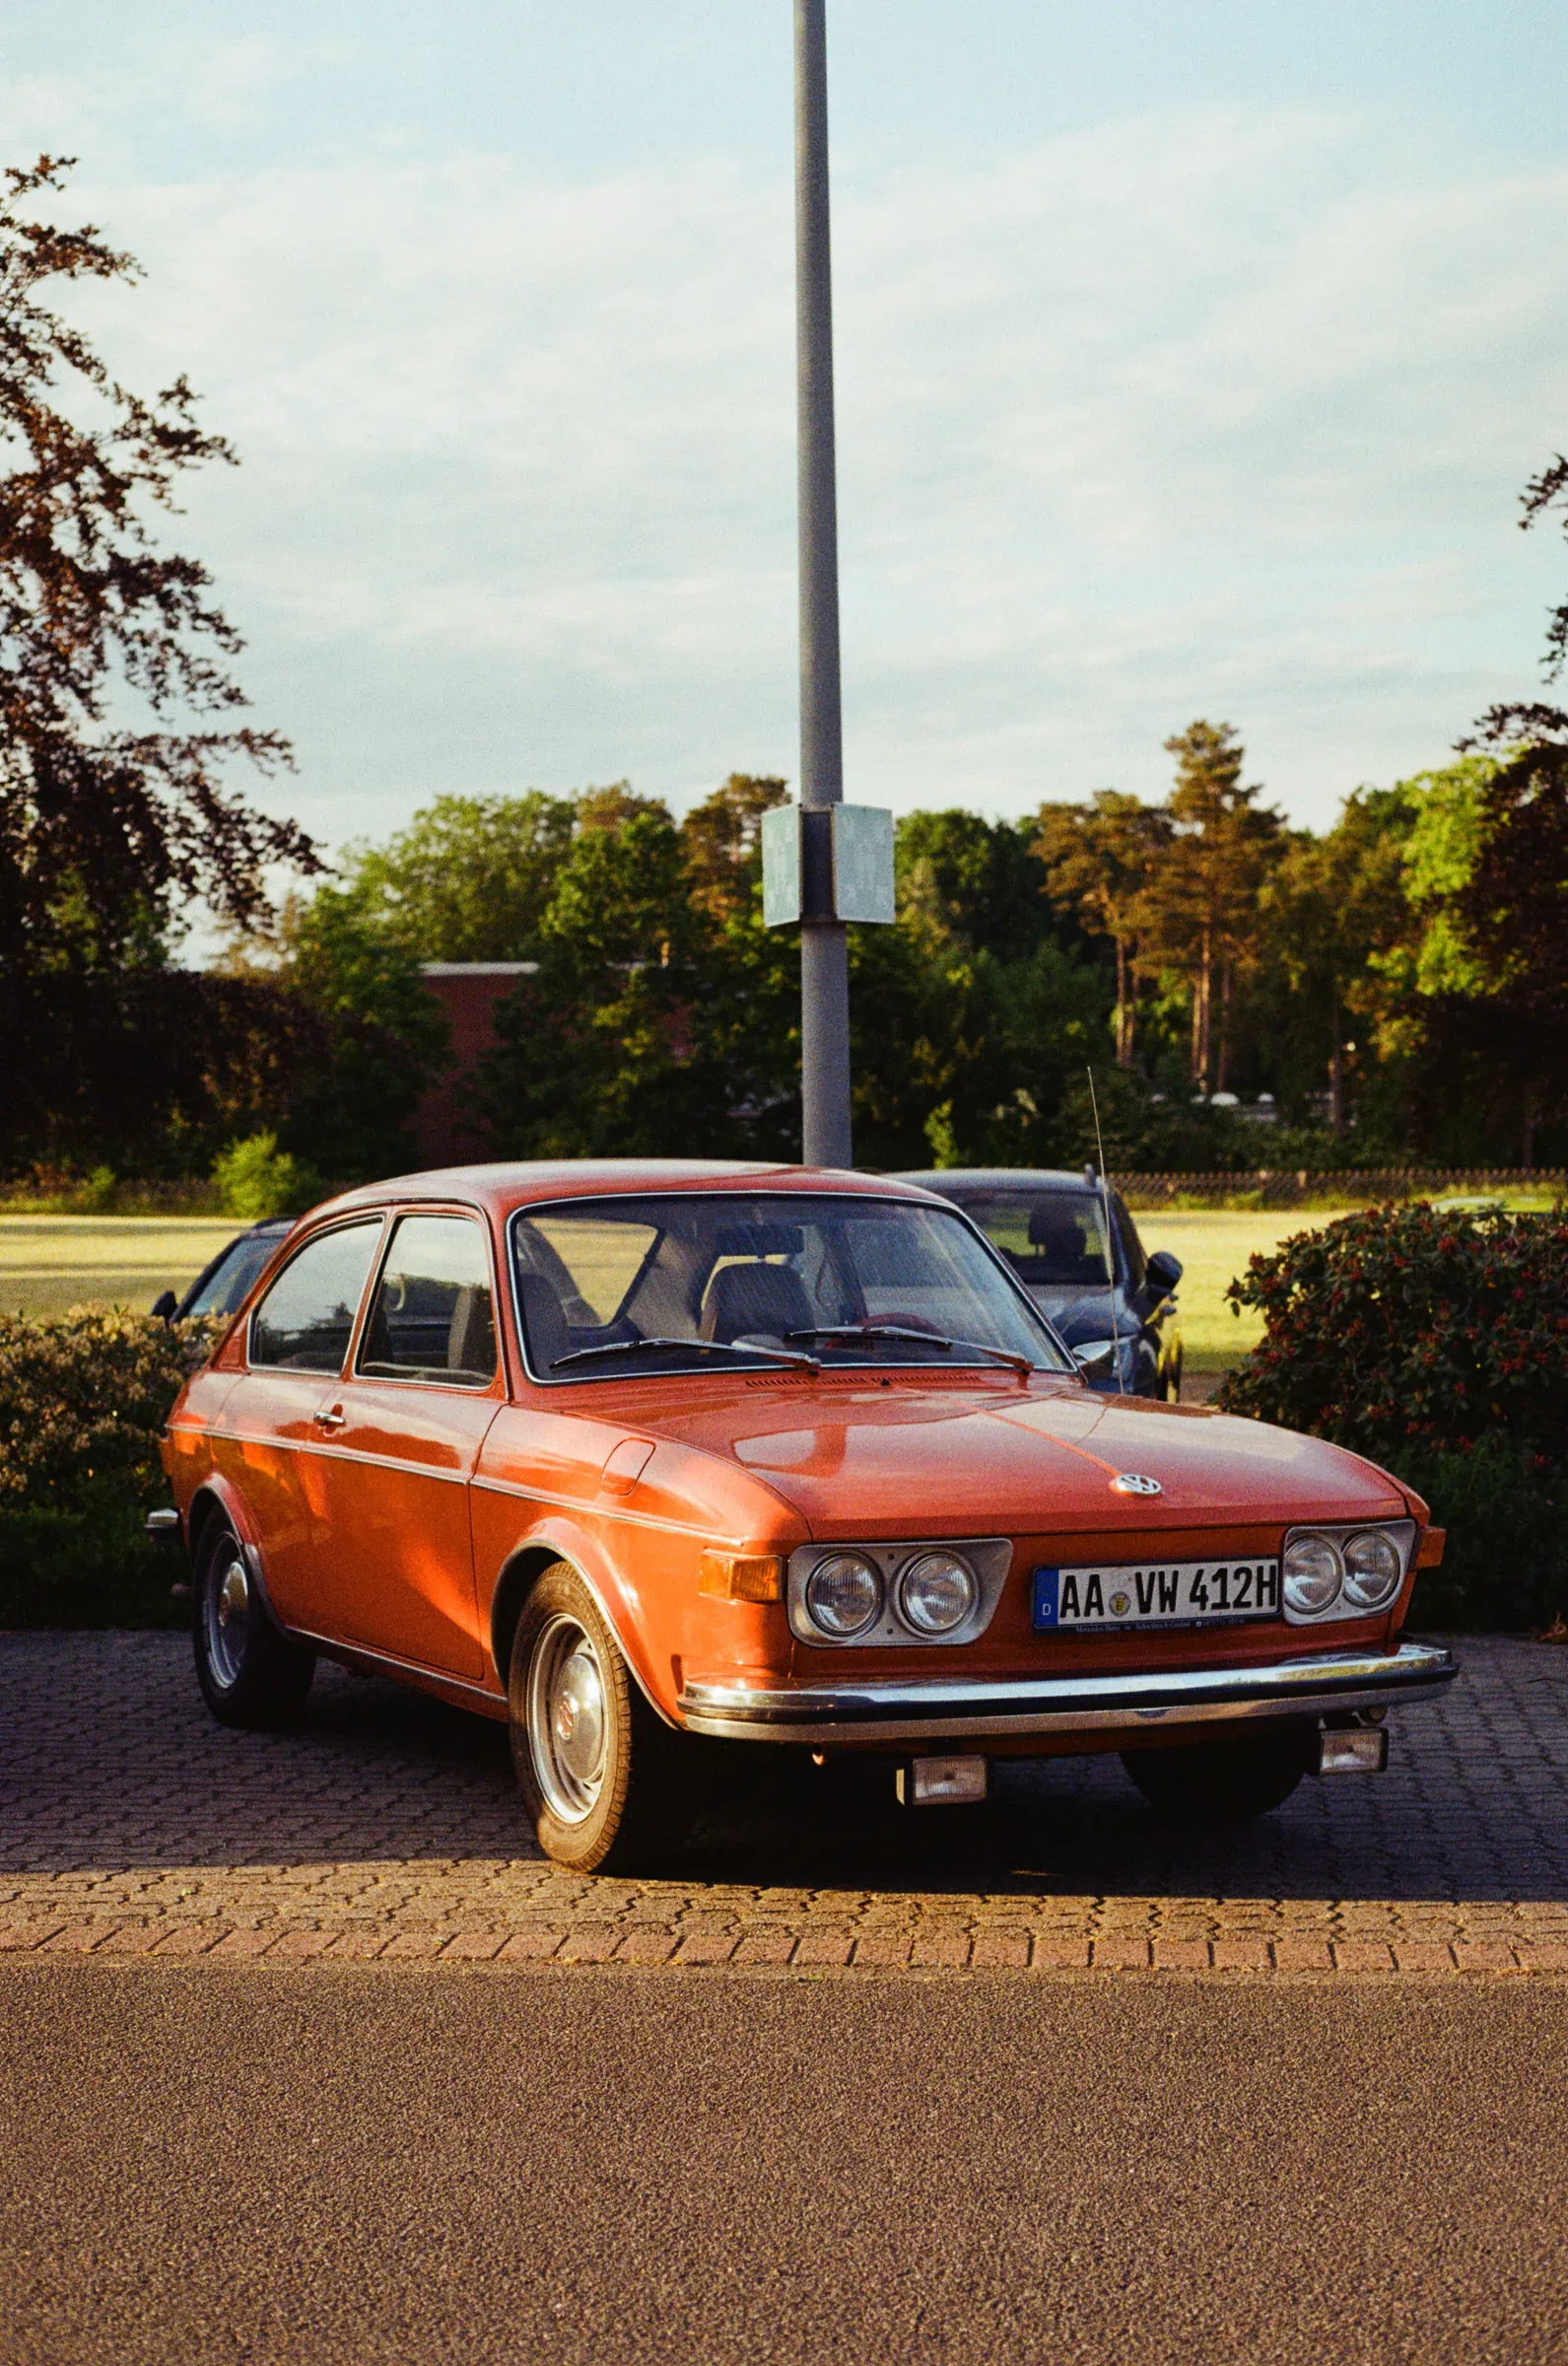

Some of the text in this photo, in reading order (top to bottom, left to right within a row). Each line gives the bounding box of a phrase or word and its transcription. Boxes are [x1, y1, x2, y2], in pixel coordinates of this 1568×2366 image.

[1059, 1565, 1276, 1617] AA VW 412H
[1042, 1603, 1052, 1616] D
